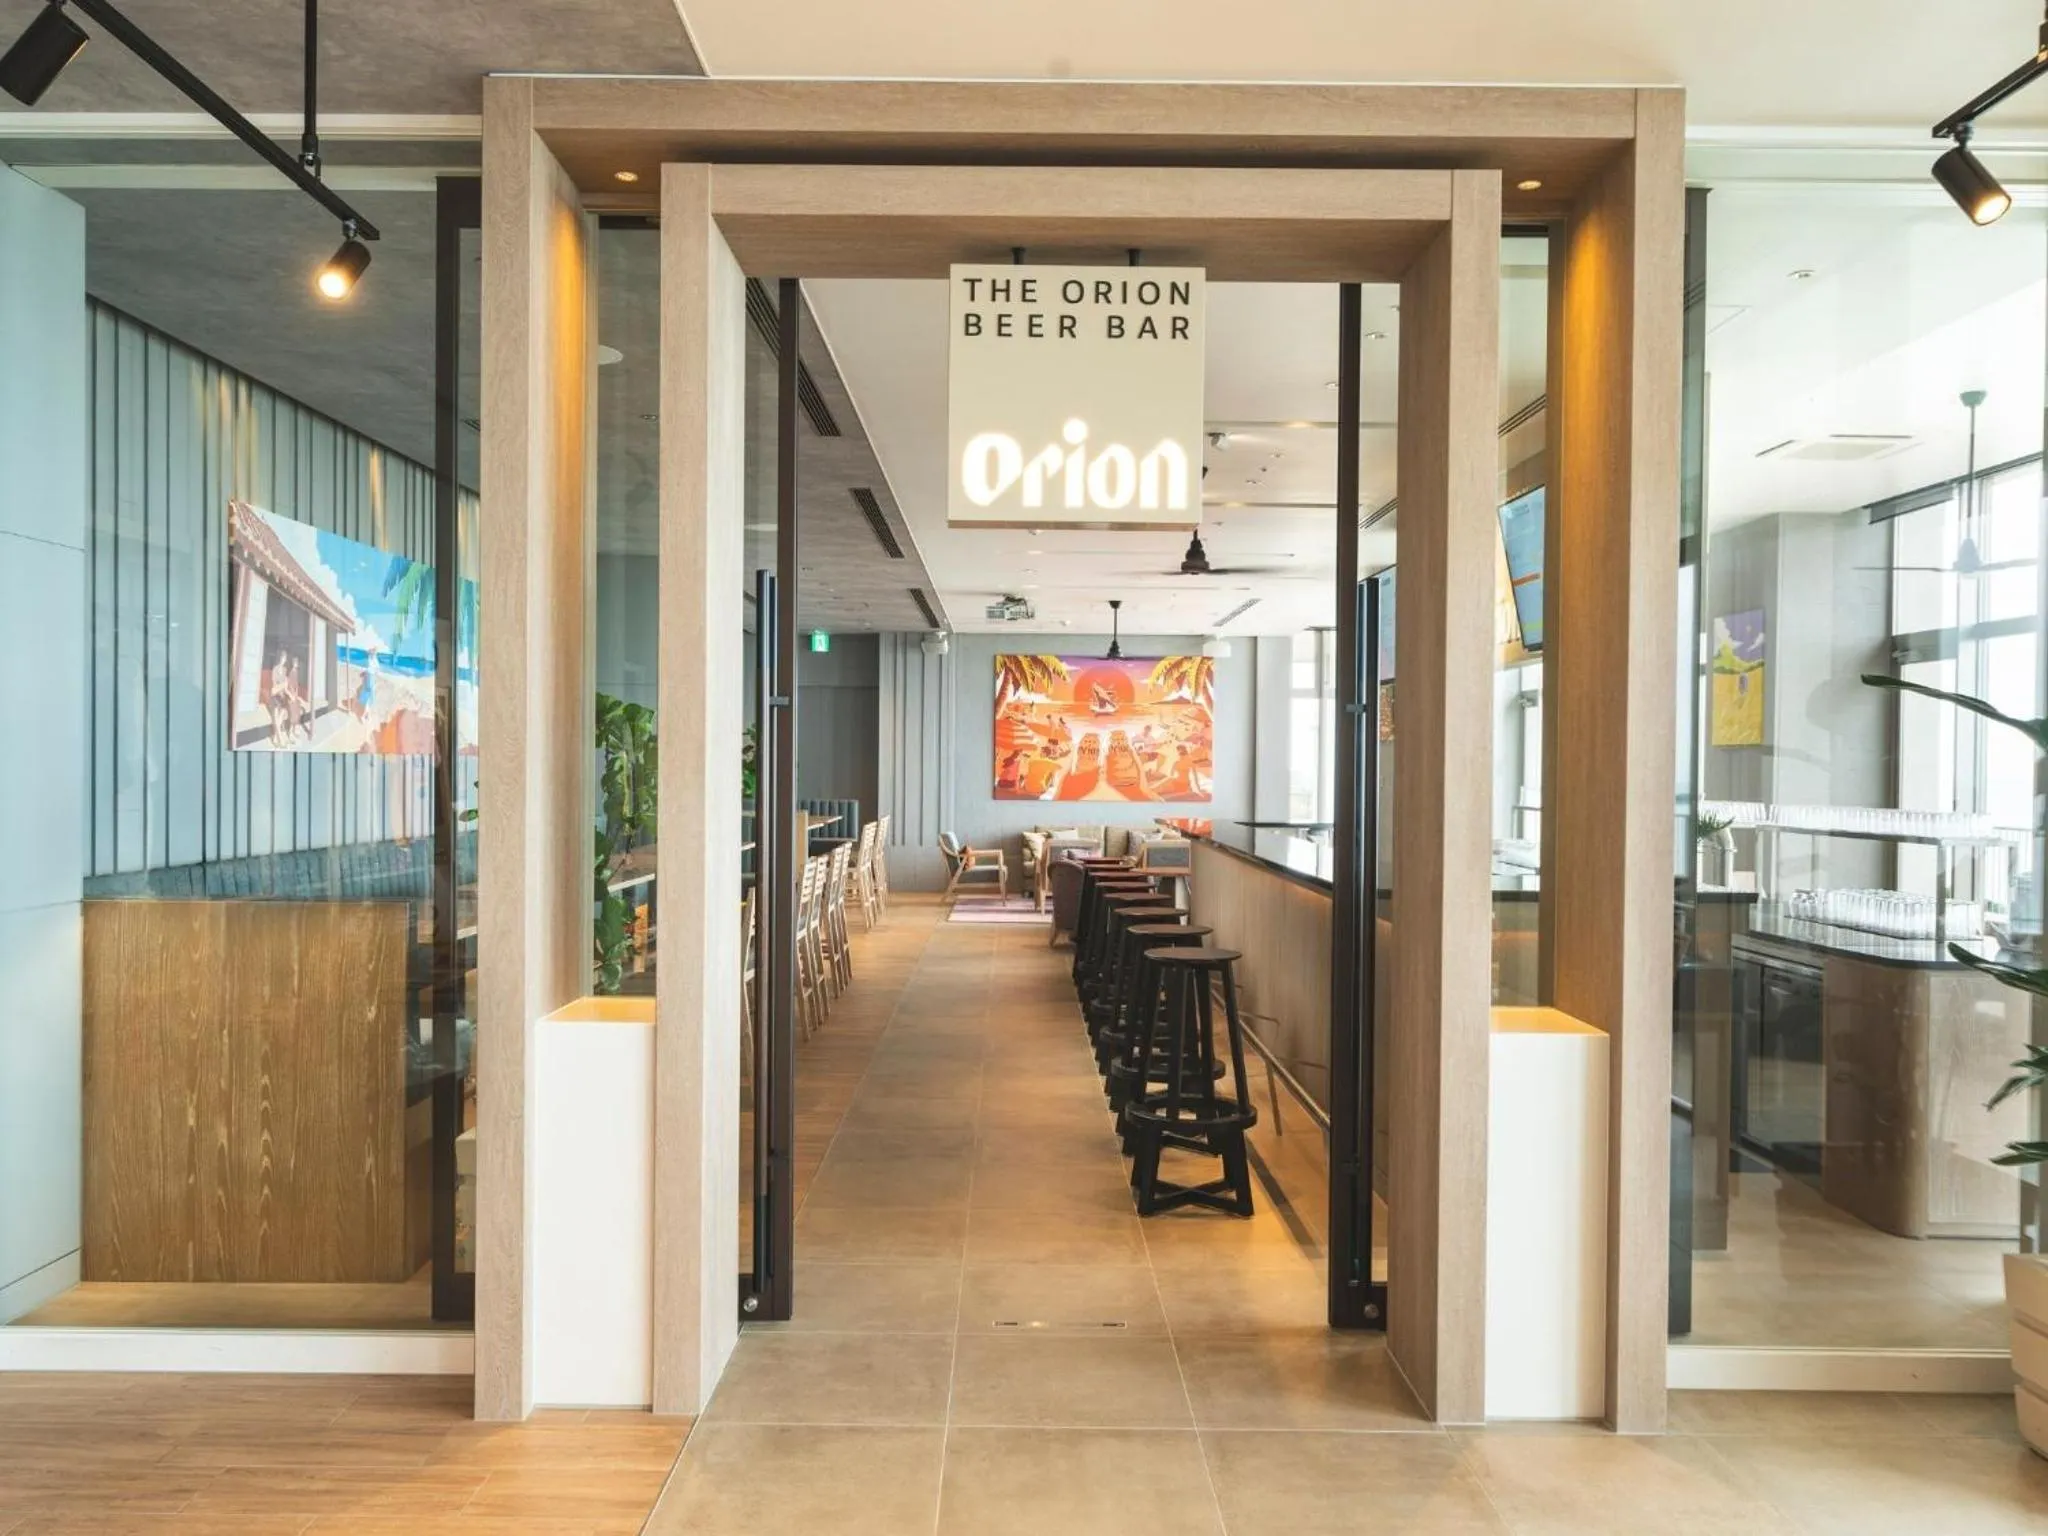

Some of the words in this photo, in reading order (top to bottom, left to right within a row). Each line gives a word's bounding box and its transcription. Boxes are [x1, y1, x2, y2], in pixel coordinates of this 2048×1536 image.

[963, 278, 1038, 303] THE
[1061, 279, 1190, 305] ORION
[963, 313, 1077, 339] BEER
[1106, 315, 1190, 340] BAR
